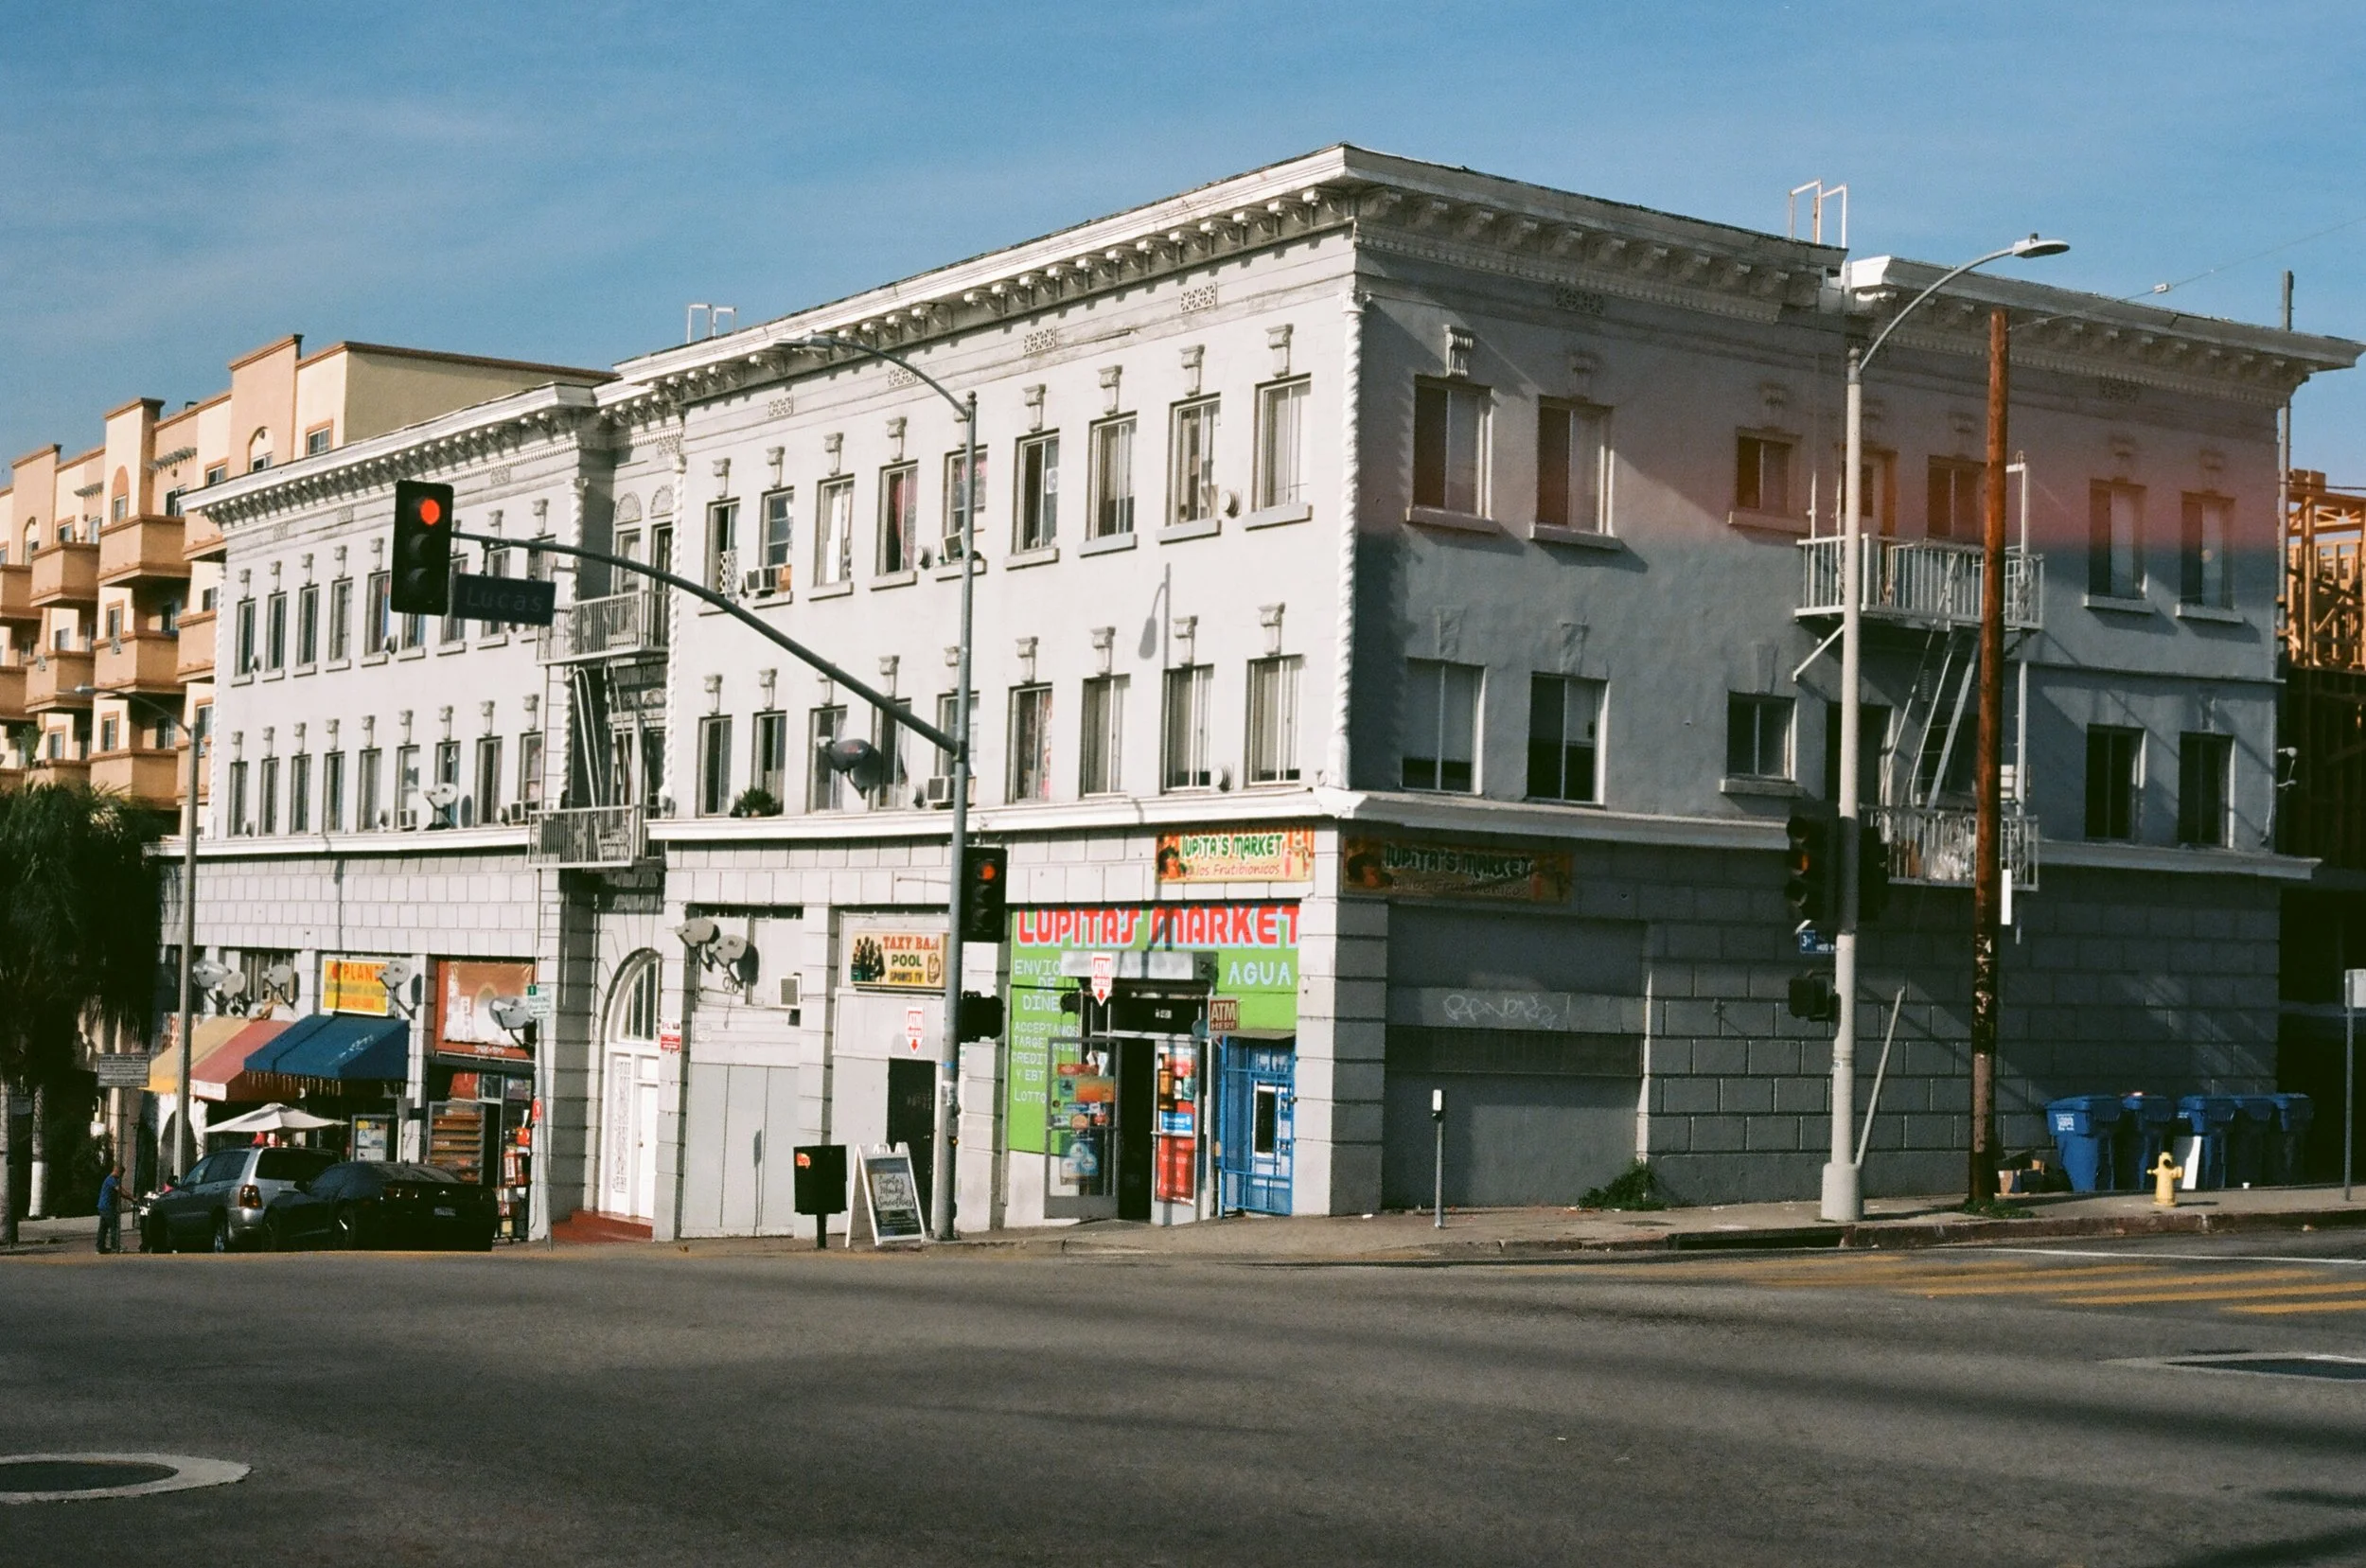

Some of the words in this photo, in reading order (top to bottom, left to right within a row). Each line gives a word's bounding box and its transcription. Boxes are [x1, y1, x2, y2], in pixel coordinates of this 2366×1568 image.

[467, 586, 543, 613] Lucas
[1232, 834, 1283, 860] MARKET
[1016, 907, 1140, 945] LUPITA'S
[1150, 903, 1299, 945] MARKET
[883, 936, 912, 950] TAXY
[892, 954, 923, 967] POOL
[1093, 959, 1111, 977] ATM
[1227, 960, 1292, 986] AGUA
[1037, 977, 1056, 993] DE
[1022, 995, 1062, 1012] DINE
[1210, 1002, 1236, 1021] ATM
[1014, 1022, 1079, 1037] ACCEPTAMOS
[1210, 1021, 1236, 1030] HERE
[1024, 1068, 1045, 1082] EBT
[1014, 1087, 1047, 1104] LOTTO
